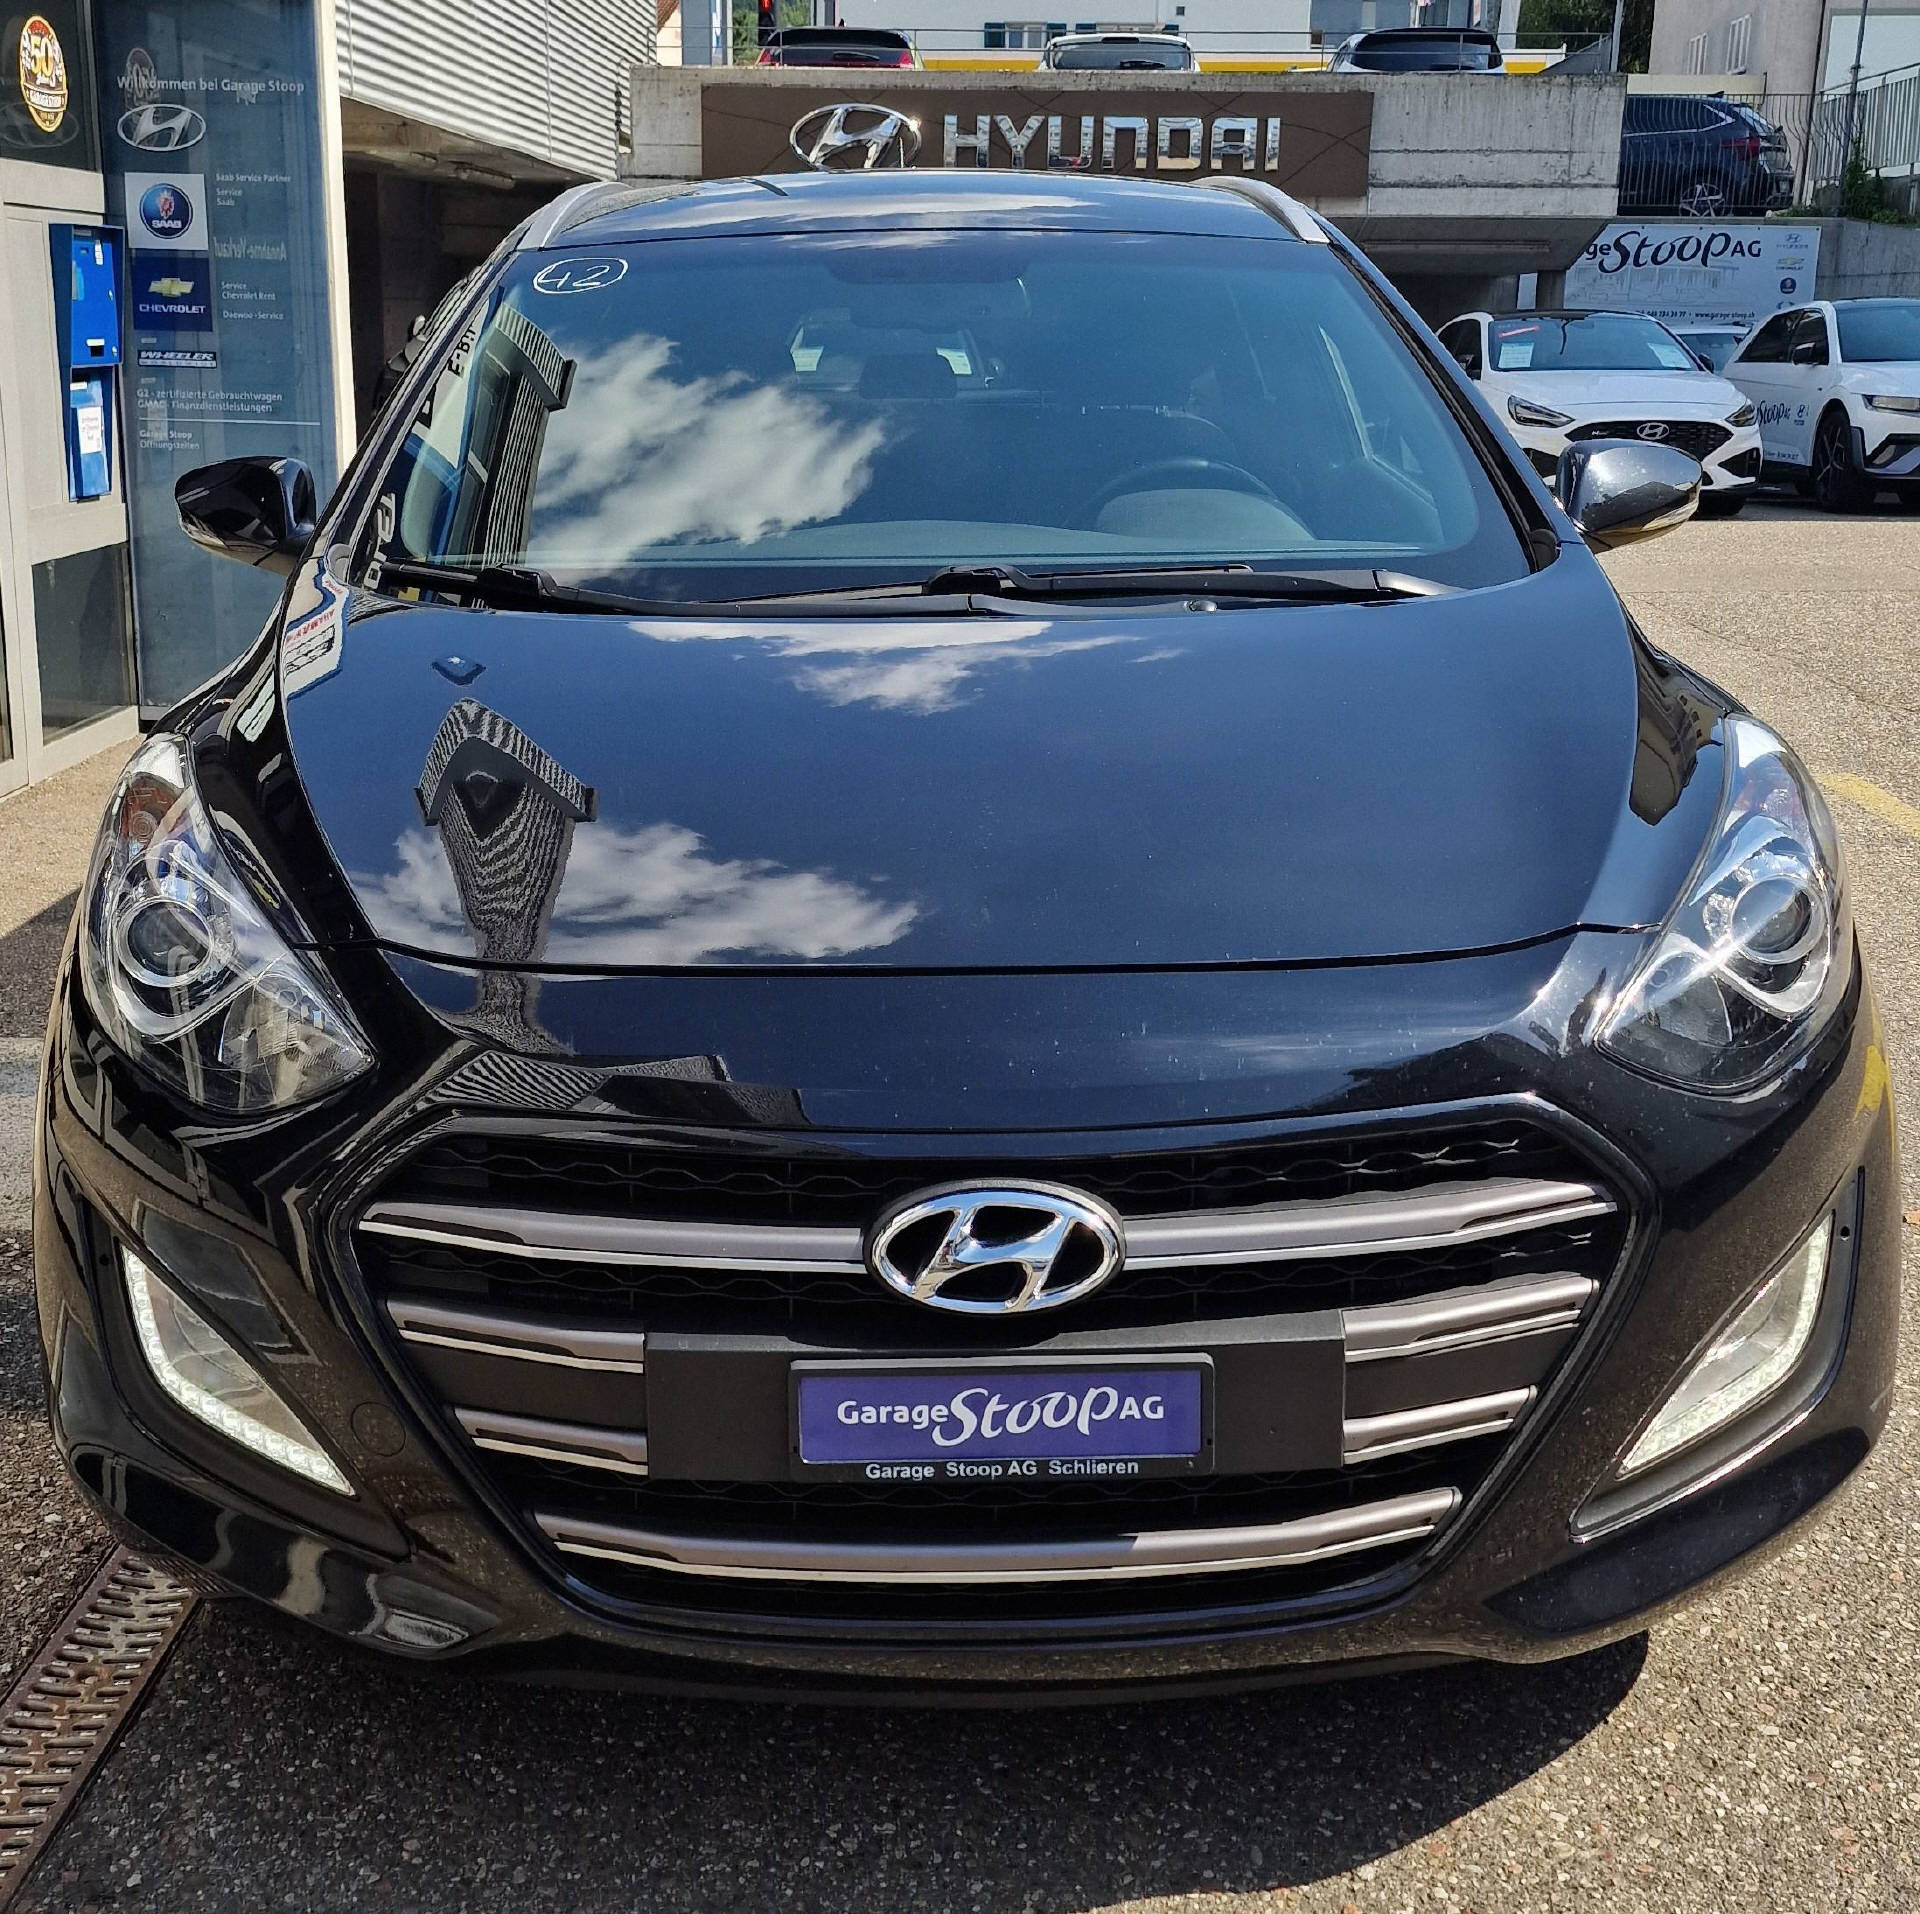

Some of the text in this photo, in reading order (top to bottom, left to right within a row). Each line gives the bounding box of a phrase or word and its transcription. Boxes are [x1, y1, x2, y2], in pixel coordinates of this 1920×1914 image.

[30, 35, 55, 77] 50
[117, 75, 305, 95] Willkommen bei Garage Stoop
[944, 115, 1281, 171] HYUNDAI
[216, 173, 291, 183] Saab Service Partner
[216, 188, 243, 196] Service
[216, 198, 235, 206] Saab
[152, 219, 182, 229] SAAB
[1598, 231, 1731, 274] Stoop
[1731, 240, 1762, 258] AG
[221, 282, 247, 290] Service
[221, 292, 258, 300] Chevrolet
[139, 303, 206, 314] CHEVROLET
[141, 351, 215, 361] WHEELER
[155, 389, 208, 400] zertifizierte
[208, 391, 283, 402] Gebrauchtwagen
[171, 400, 273, 414] Finanzdienstleistungen
[169, 430, 193, 440] Stoop
[837, 1386, 1165, 1447] Garage Stoop AG
[865, 1459, 1139, 1481] Garage Stoop AG Schlieren
